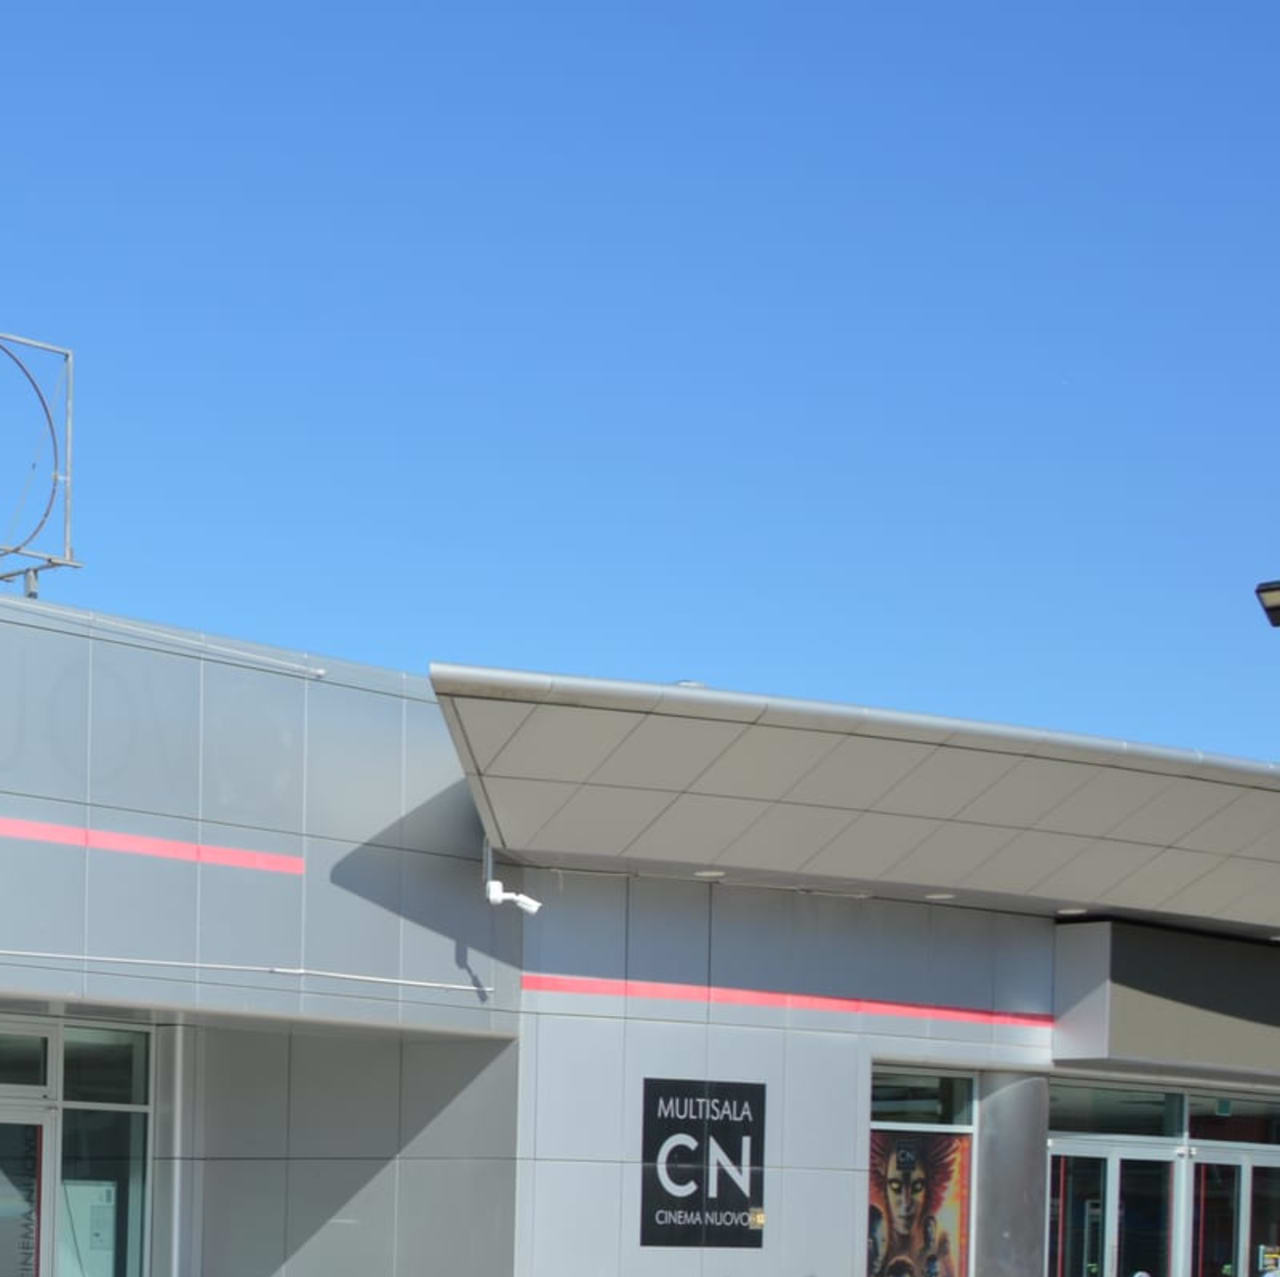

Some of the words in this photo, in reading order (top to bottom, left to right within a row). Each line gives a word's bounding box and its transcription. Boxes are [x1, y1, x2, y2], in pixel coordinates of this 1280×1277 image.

[657, 1097, 753, 1122] MULTISALA
[657, 1133, 751, 1199] CN
[654, 1209, 704, 1227] CINEMA
[704, 1210, 751, 1228] NUOVO
